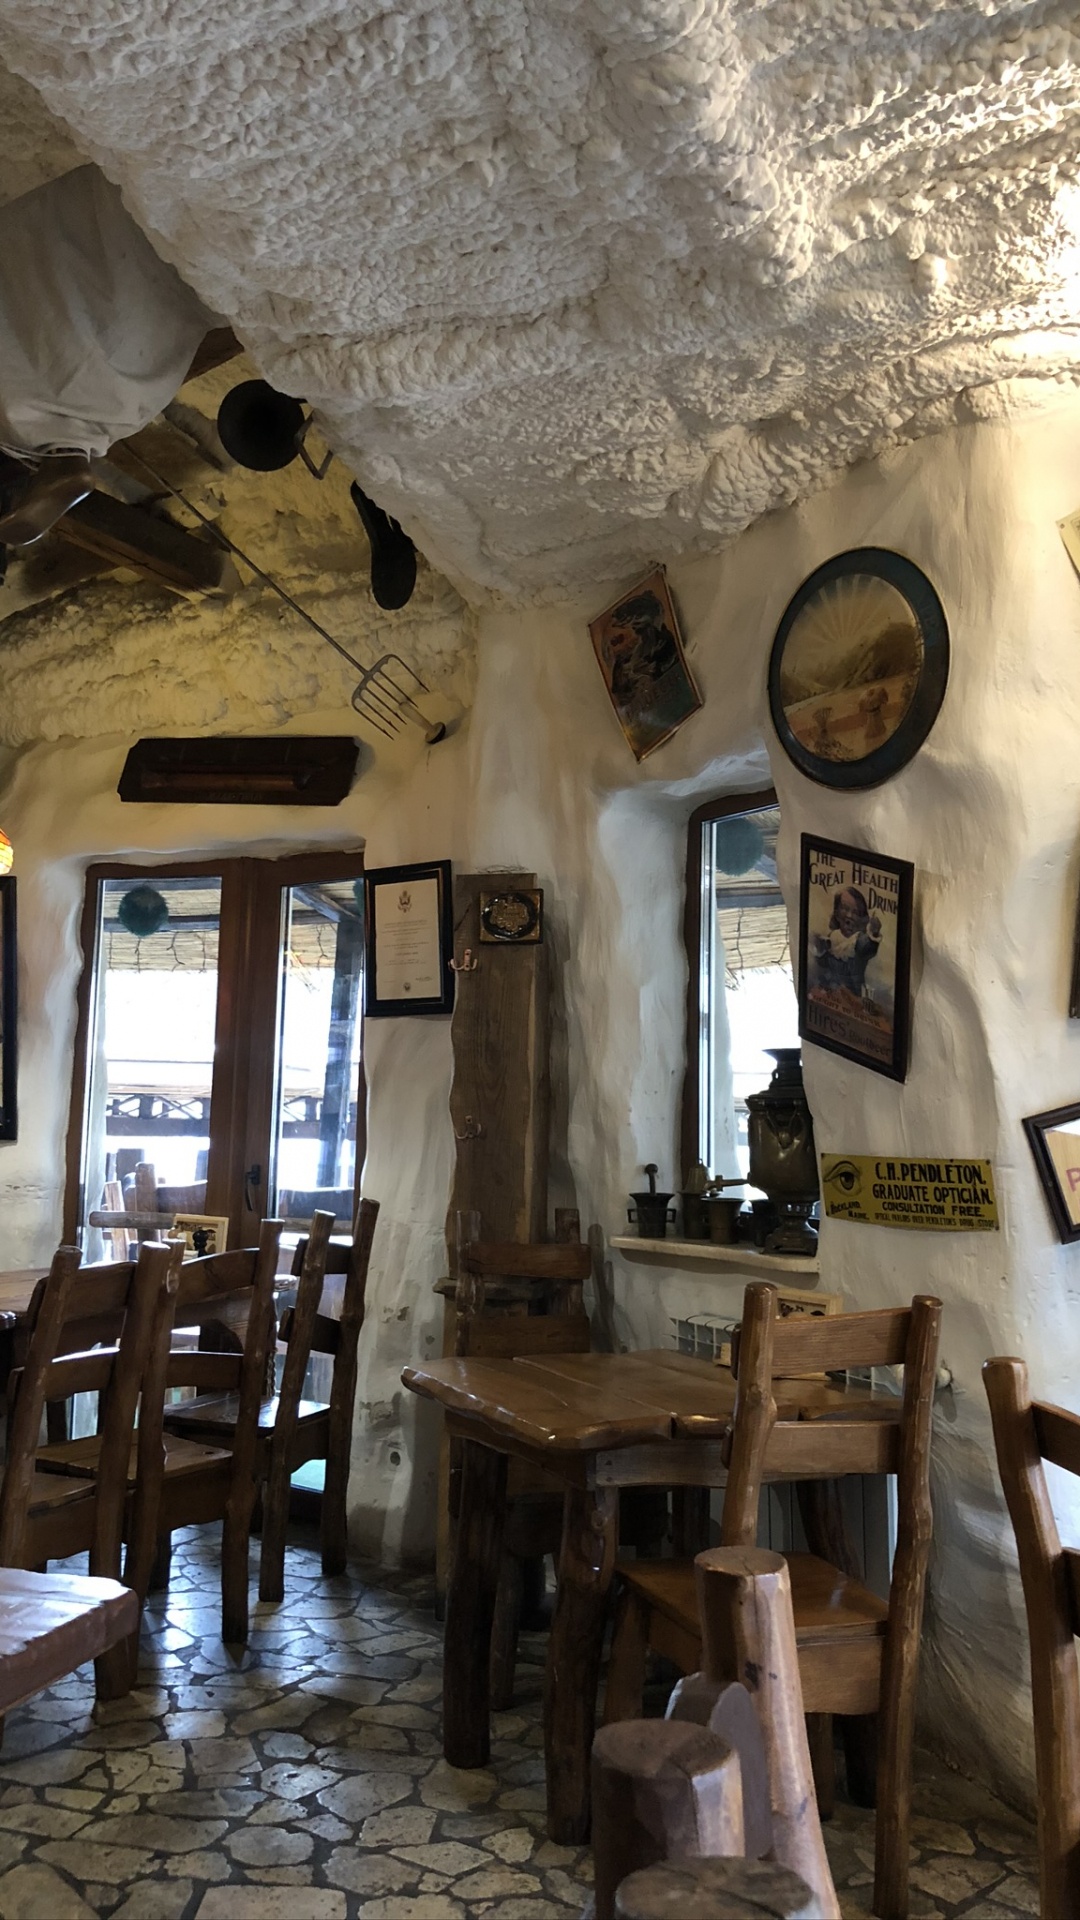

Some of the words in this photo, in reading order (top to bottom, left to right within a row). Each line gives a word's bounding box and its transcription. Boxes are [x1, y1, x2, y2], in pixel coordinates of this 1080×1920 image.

[816, 851, 836, 867] THE
[809, 863, 845, 893] GREAT
[852, 862, 898, 893] HEALTH
[873, 1184, 928, 1202] GRADUATE
[882, 1201, 945, 1215] CONSULTATION
